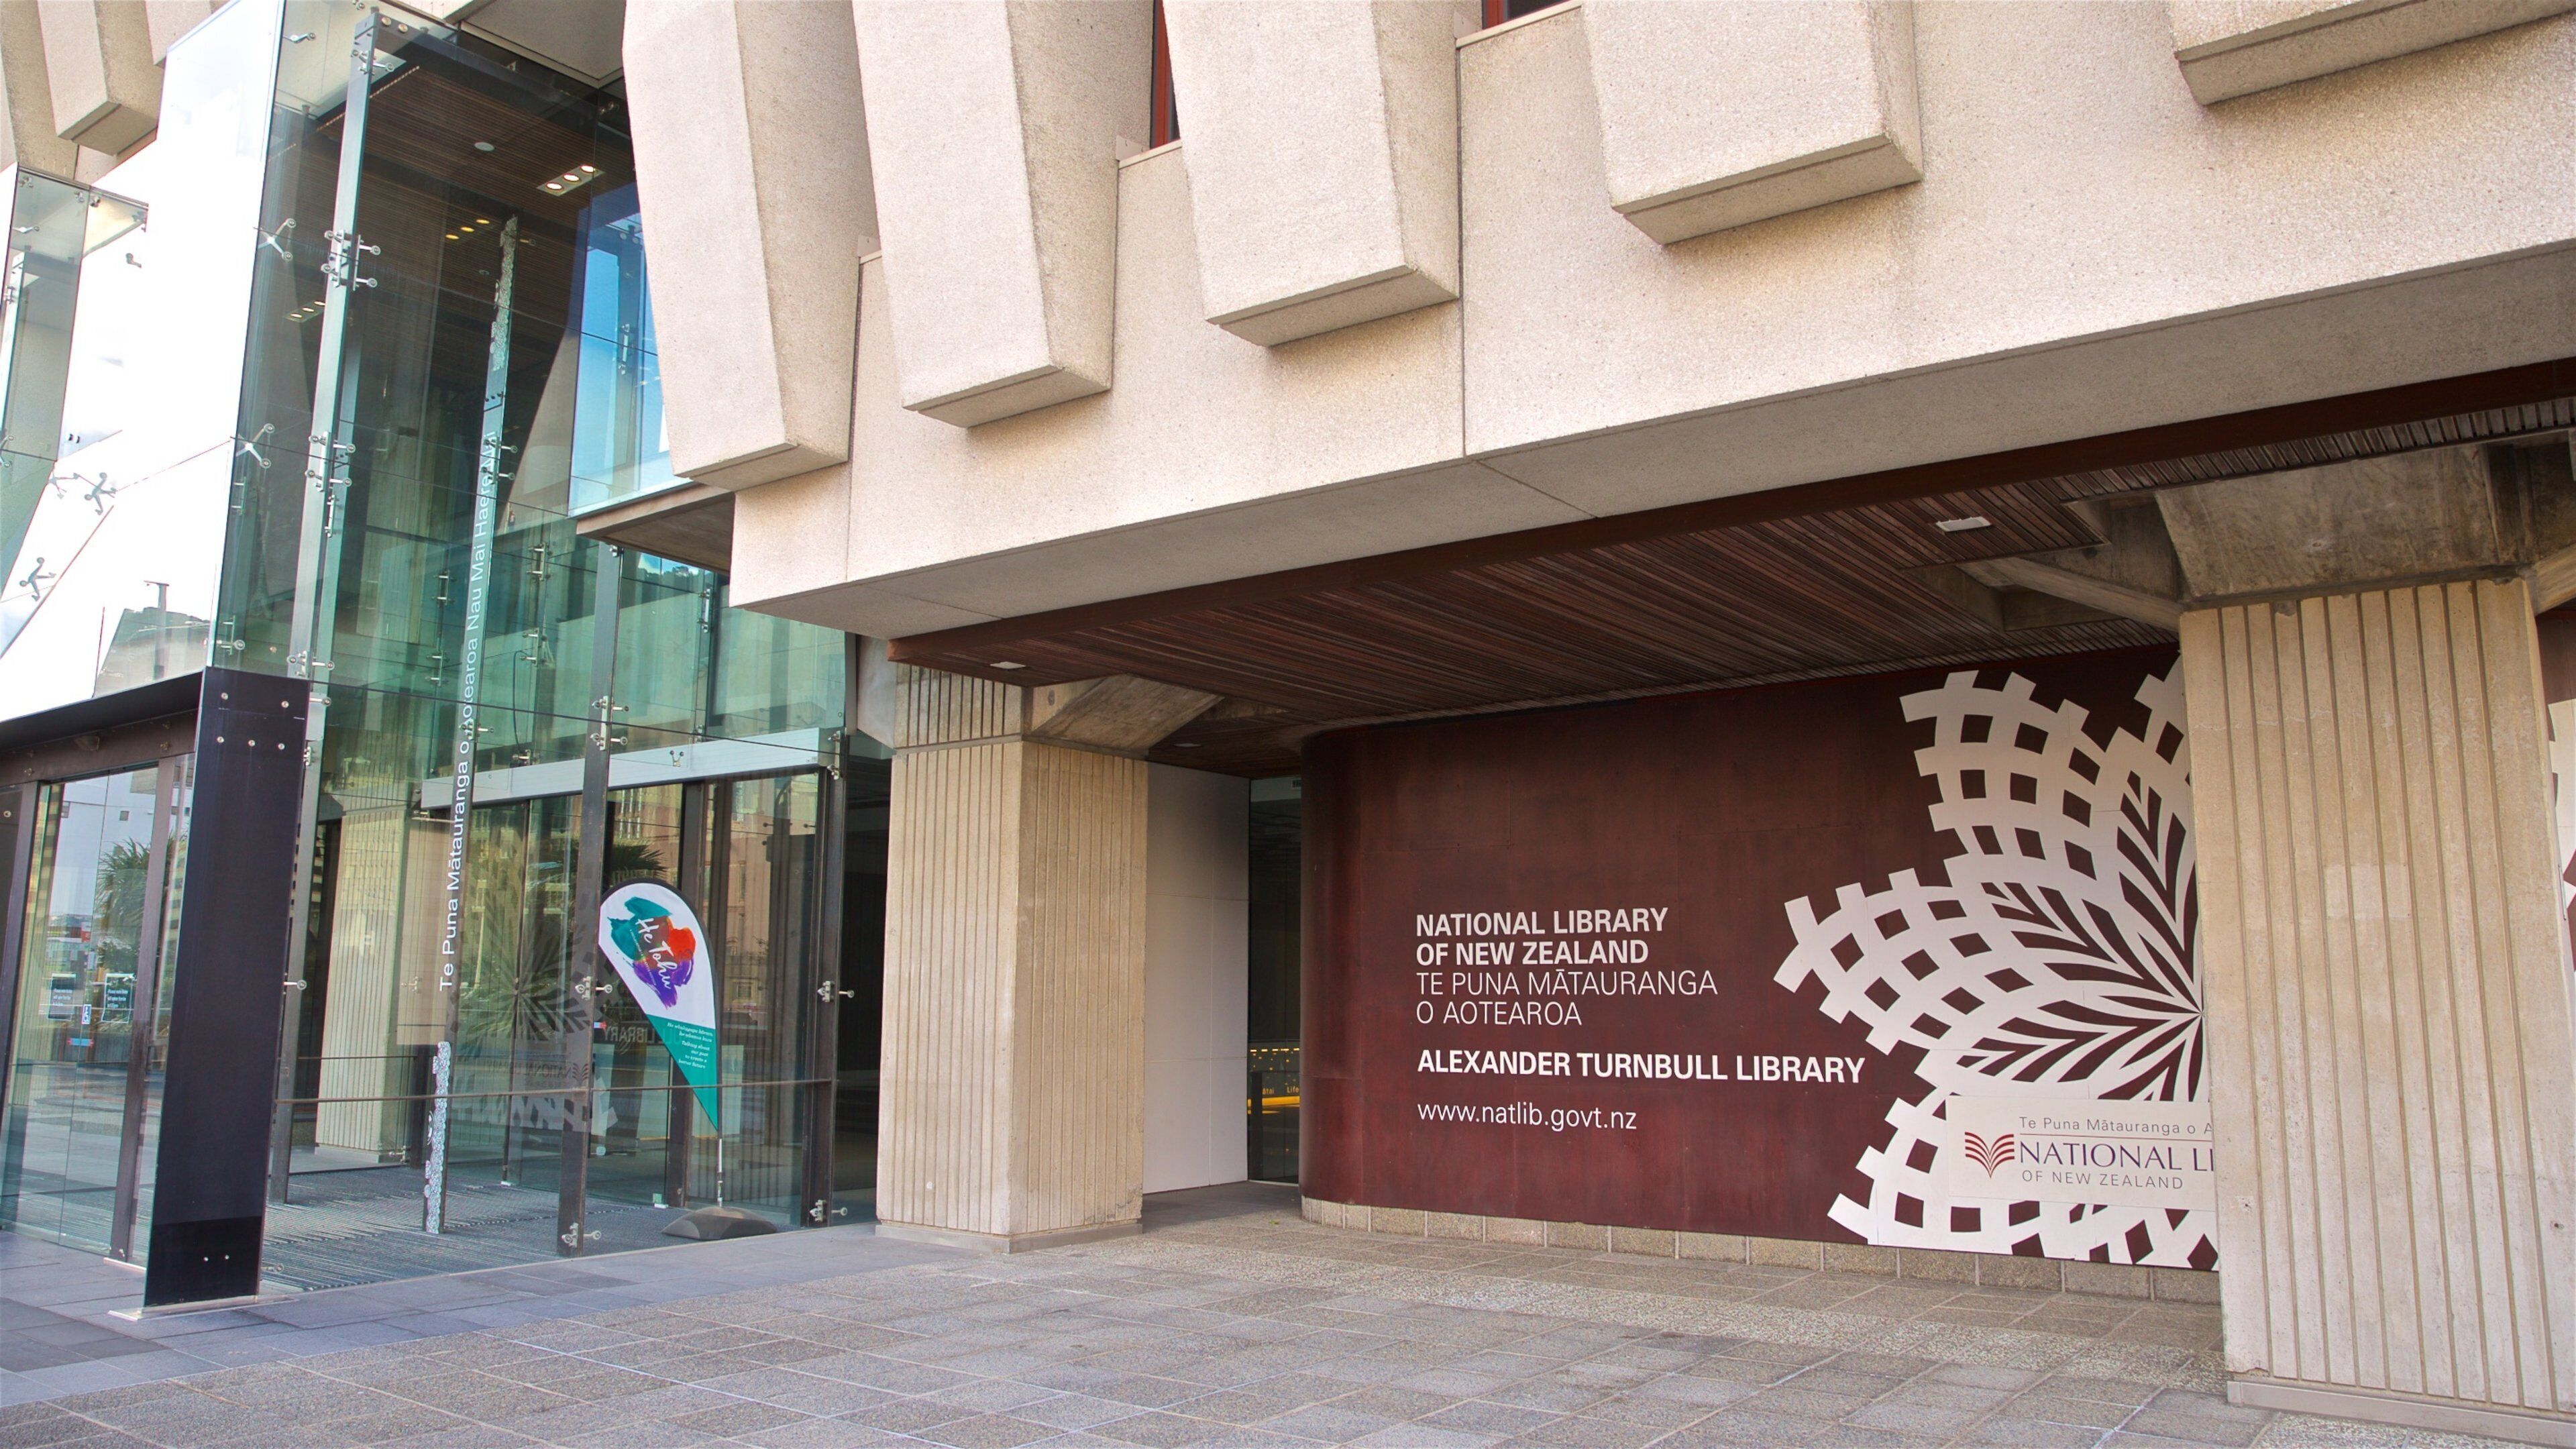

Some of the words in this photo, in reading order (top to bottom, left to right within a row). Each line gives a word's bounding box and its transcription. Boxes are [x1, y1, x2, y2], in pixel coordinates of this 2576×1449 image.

[474, 475, 494, 535] Haere
[470, 543, 486, 582] Mai
[467, 588, 482, 631] Nau
[459, 741, 470, 754] o
[447, 761, 470, 891] Mātauranga
[442, 898, 459, 955] Puna
[1416, 912, 1546, 936] NATIONAL
[1554, 907, 1668, 934] LIBRARY
[635, 918, 659, 944] He
[648, 940, 678, 989] Tohu
[1416, 943, 1448, 966] OF
[1456, 942, 1515, 965] NEW
[1522, 939, 1648, 965] ZEALAND
[439, 963, 454, 991] Te
[1416, 972, 1444, 995] TE
[1452, 971, 1520, 996] PUNA
[1529, 969, 1718, 996] MĀTAURANGA
[1416, 1001, 1434, 1024] O
[1443, 1001, 1582, 1026] AOTEAROA
[1417, 1049, 1571, 1077] ALEXANDER
[1576, 1053, 1728, 1080] TURNBULL
[1736, 1055, 1866, 1083] LIBRARY
[1417, 1101, 1637, 1132] www.natlib.govt.nz
[2019, 1116, 2037, 1129] Te
[2043, 1117, 2080, 1130] Puna
[2087, 1118, 2180, 1136] Mātauranga
[2187, 1124, 2196, 1134] o
[2019, 1140, 2182, 1171] NATIONAL
[2022, 1169, 2043, 1182] OF
[2052, 1171, 2091, 1185] NEW
[2099, 1173, 2184, 1189] ZEALAND
